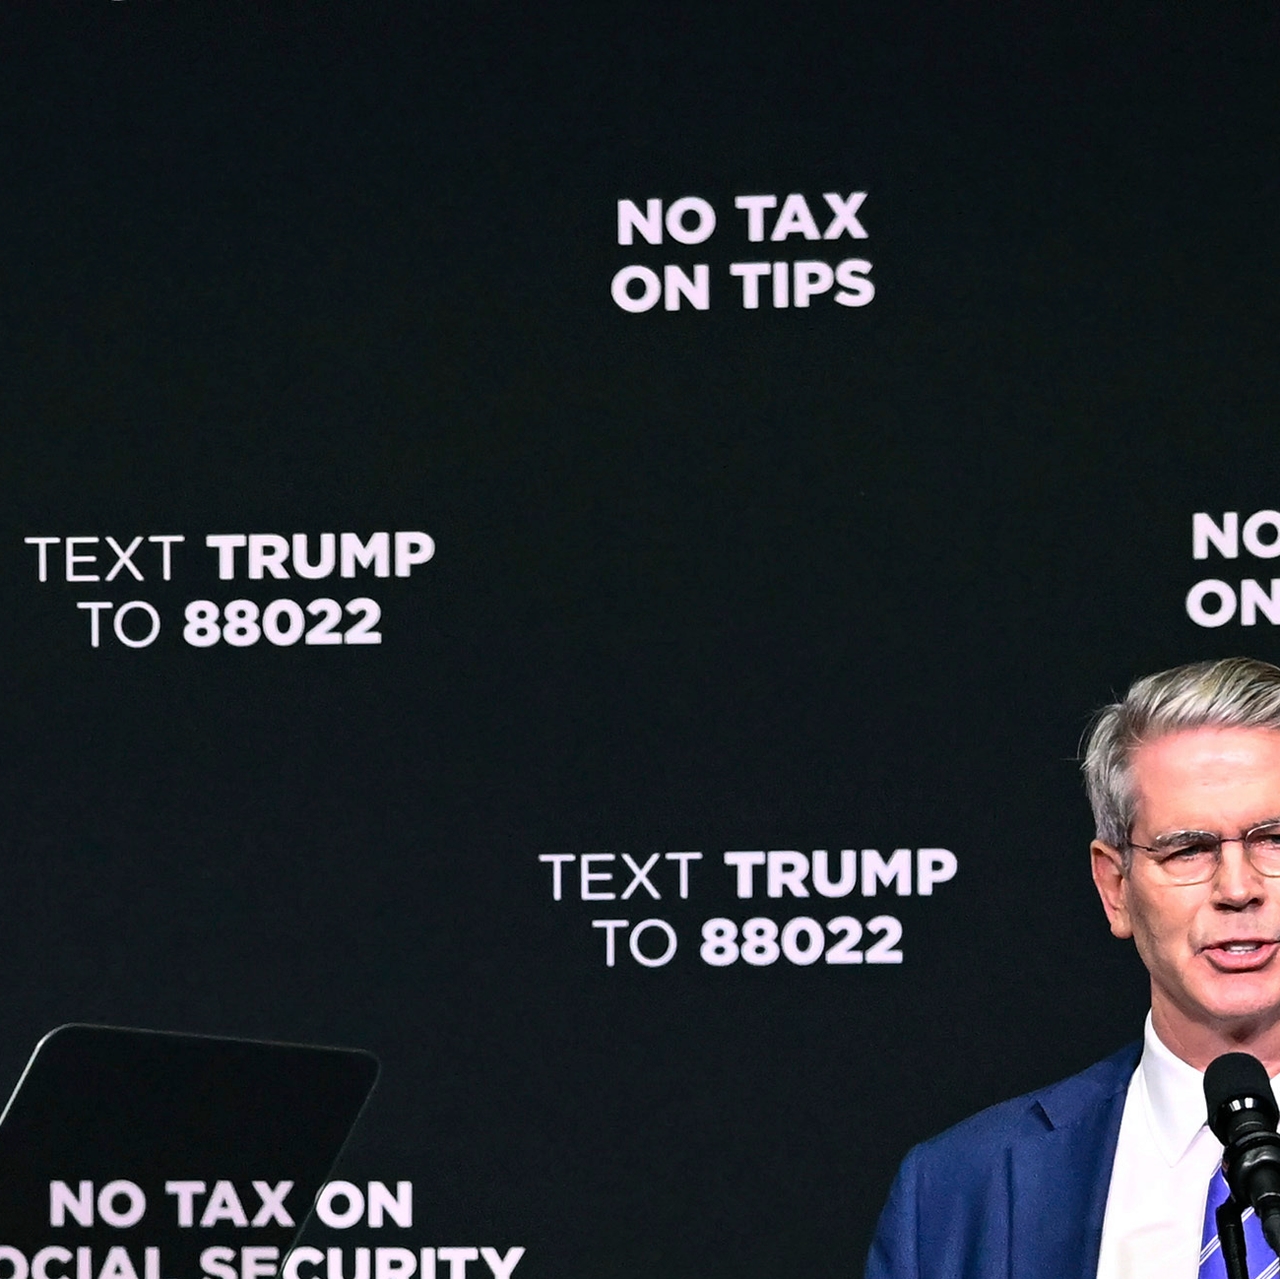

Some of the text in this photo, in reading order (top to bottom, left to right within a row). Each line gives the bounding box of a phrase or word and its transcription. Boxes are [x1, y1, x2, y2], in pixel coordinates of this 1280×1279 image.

[616, 190, 870, 247] NO TAX
[609, 257, 877, 315] ON TIPS
[23, 530, 437, 584] TEXT TRUMP
[75, 596, 383, 650] TO 88022
[537, 847, 959, 902] TEXT TRUMP
[590, 914, 905, 969] TO 88022
[48, 1178, 414, 1230] NO TAX ON
